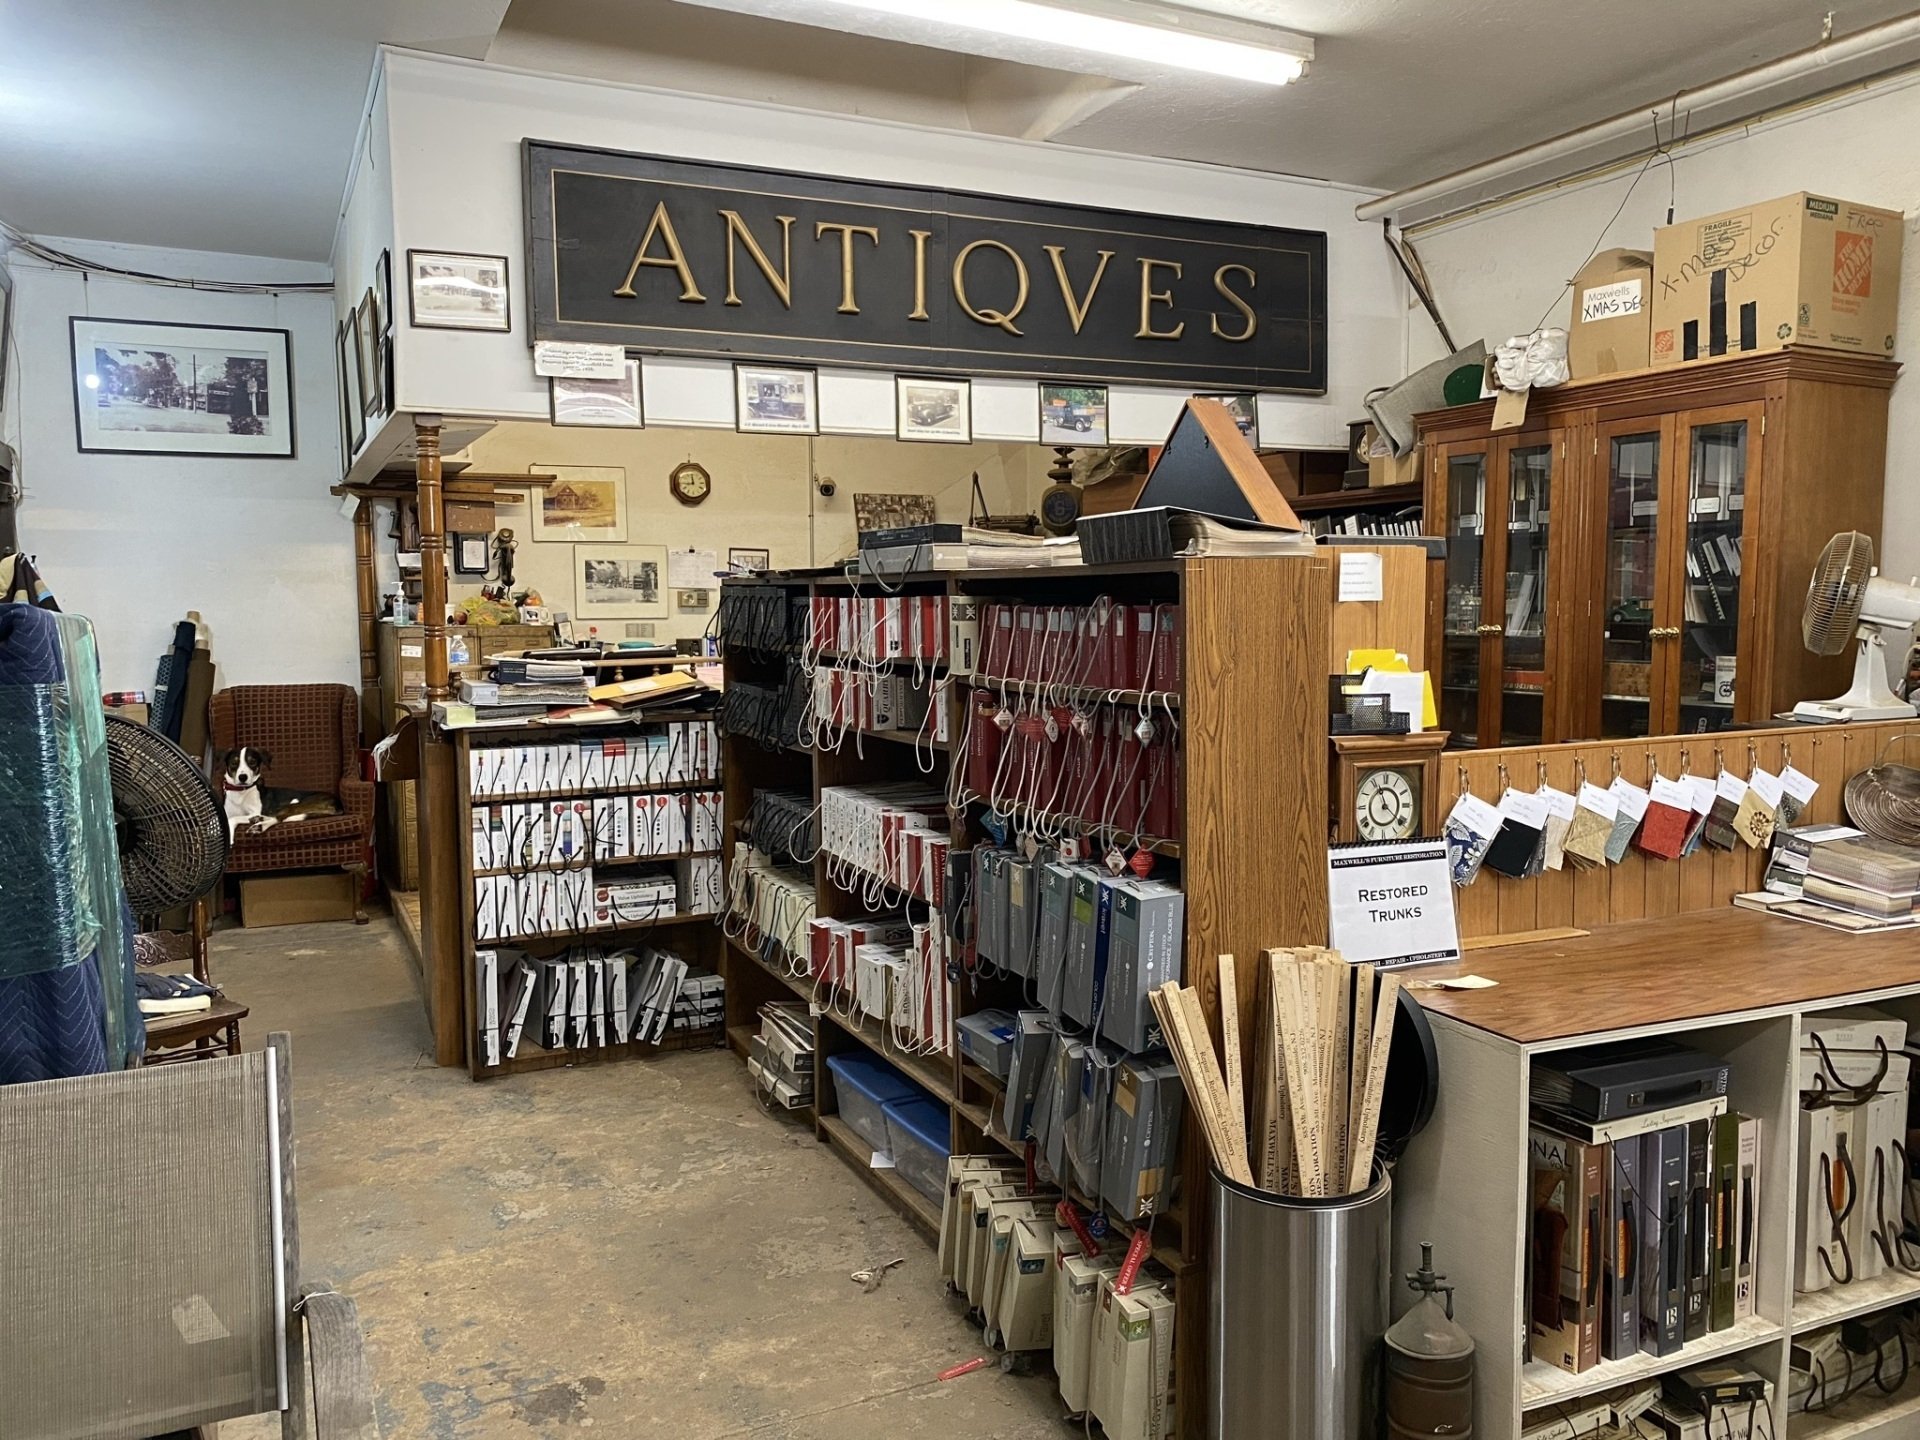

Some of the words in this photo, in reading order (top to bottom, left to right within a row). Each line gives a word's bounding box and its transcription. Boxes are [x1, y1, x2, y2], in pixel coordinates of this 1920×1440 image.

[1808, 200, 1836, 213] MEDIUM
[1704, 220, 1732, 232] FRAGILE
[613, 201, 1257, 341] ANTIQVES
[1834, 233, 1872, 293] HOME
[1588, 286, 1630, 303] Maxwells
[1584, 299, 1619, 322] XMAS
[1333, 858, 1370, 867] MAXWELL'S
[1370, 855, 1403, 864] FURNITURE
[1403, 851, 1444, 861] RESTORATION
[1267, 1120, 1277, 1178] MAXWELL'S
